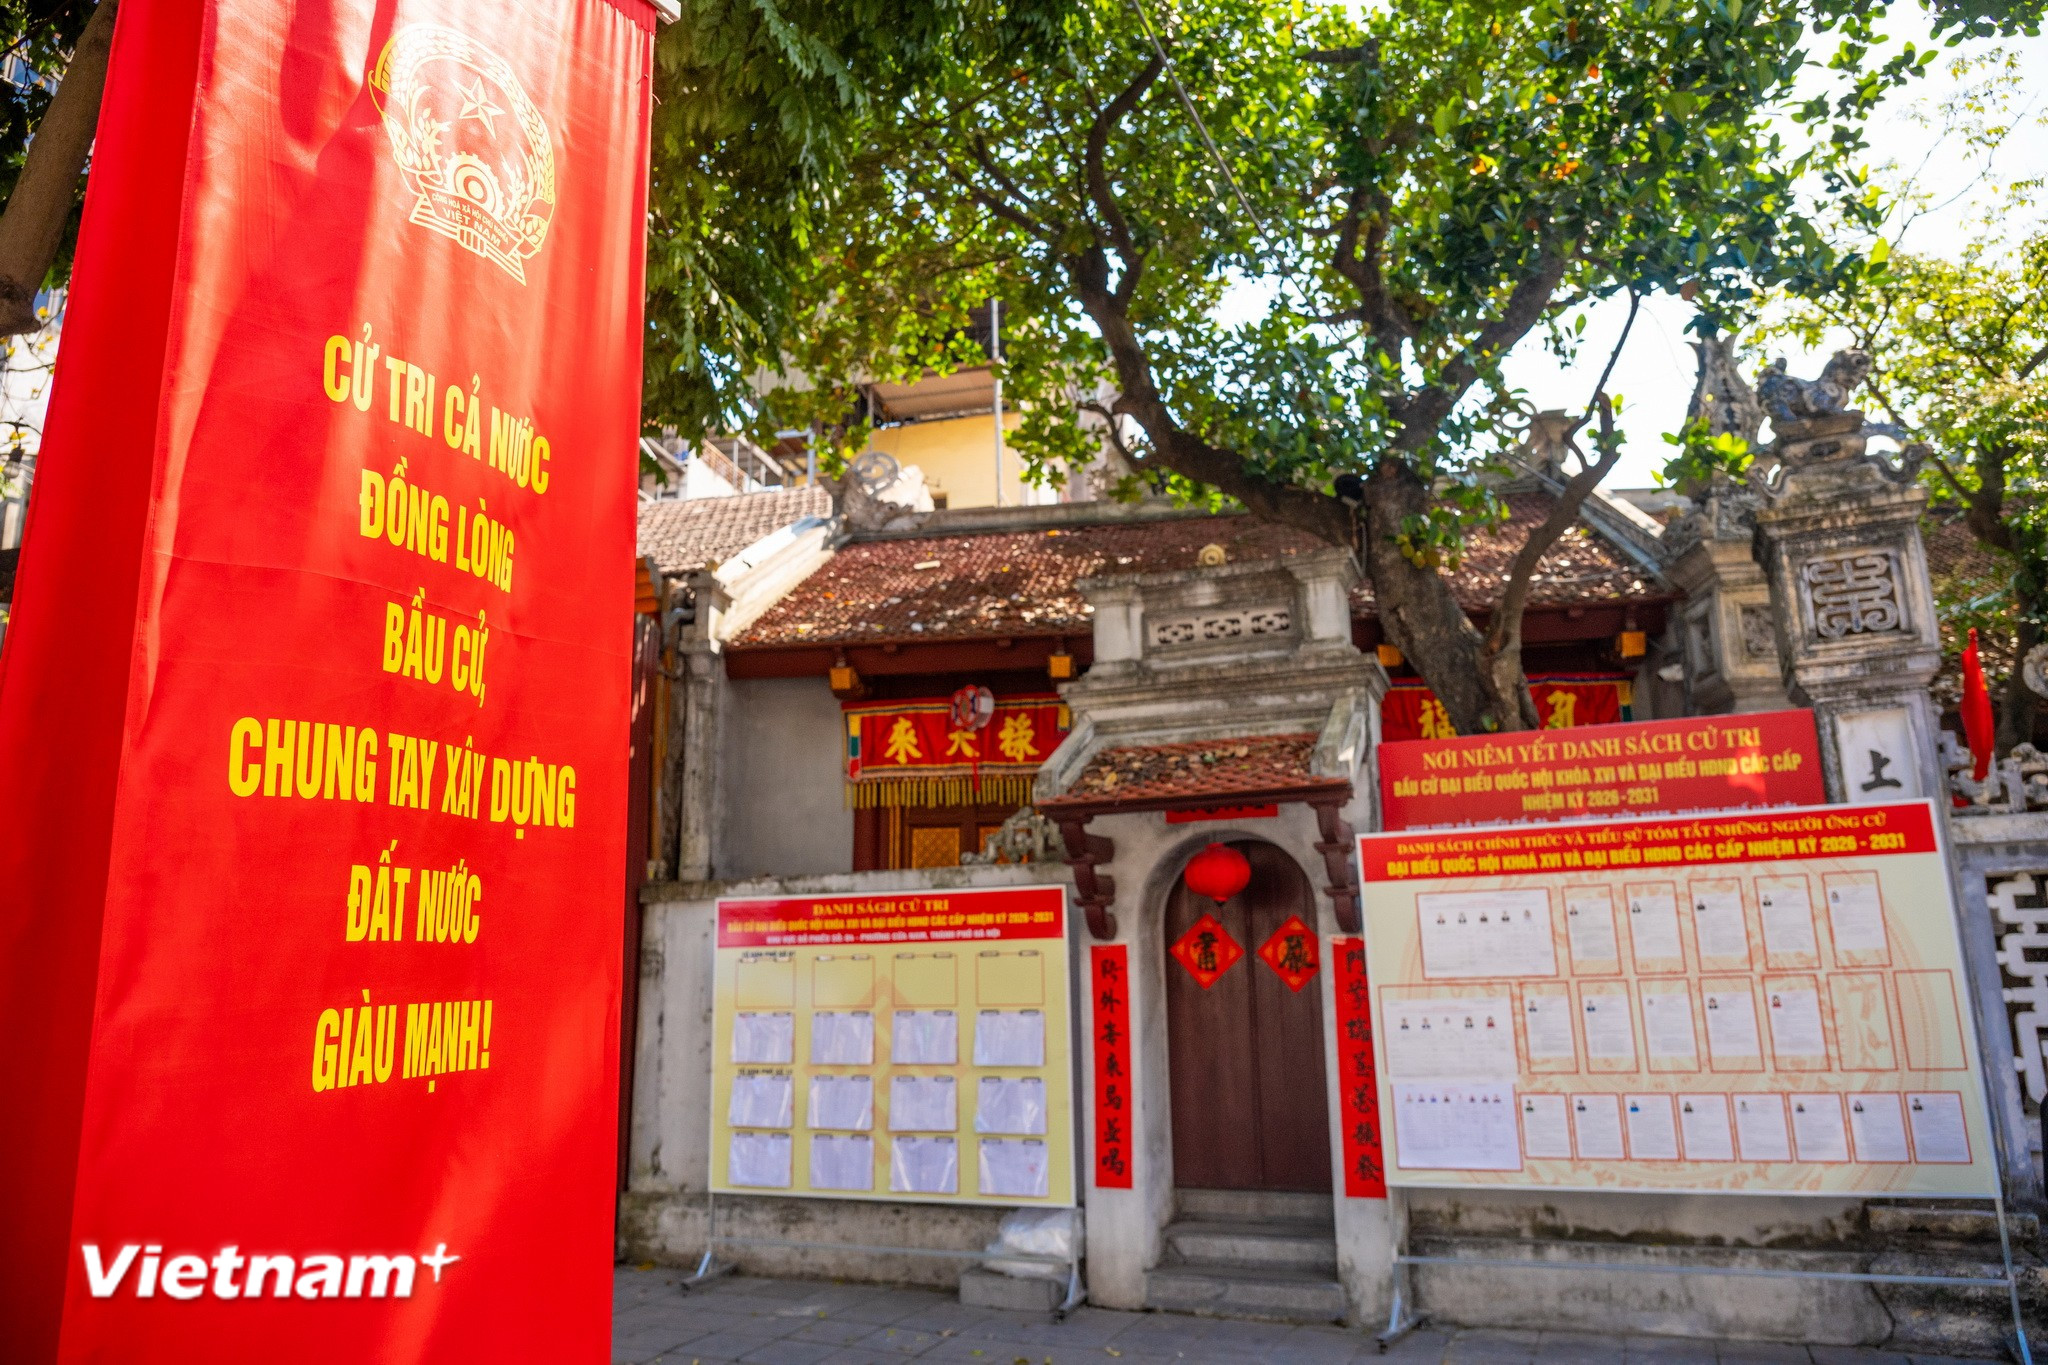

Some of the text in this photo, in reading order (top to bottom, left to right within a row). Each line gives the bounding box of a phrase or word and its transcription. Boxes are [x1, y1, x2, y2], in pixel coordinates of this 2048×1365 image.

[442, 208, 501, 247] VIỆT NAM
[323, 322, 551, 495] CỬ TRI CẢ NƯỚC
[359, 455, 515, 593] ĐỒNG LÒNG
[382, 586, 489, 708] BẦU CỬ,
[1423, 724, 1761, 770] NƠI NIÊM YẾT DANH SÁCH CỬ TRI
[228, 716, 576, 839] CHUNG TAY XÂY DỰNG
[1420, 774, 1438, 796] CỬ
[1494, 768, 1529, 791] QUỐC
[1531, 769, 1554, 790] HỘI
[1594, 766, 1616, 784] XVI
[1617, 762, 1636, 782] VÀ
[1740, 752, 1769, 774] CÁC
[1772, 748, 1802, 772] CẤP
[1567, 790, 1584, 809] KỲ
[1397, 842, 1435, 855] DANH
[1436, 838, 1473, 854] SÁCH
[1475, 835, 1521, 853] CHÍNH
[1522, 832, 1562, 849] THỨC
[1563, 830, 1584, 846] VÀ
[1643, 823, 1679, 842] TÓM
[1714, 820, 1769, 838] NHỮNG
[1771, 816, 1823, 835] NGƯỜI
[1825, 814, 1860, 831] ỨNG
[1862, 810, 1887, 828] CỬ
[1441, 853, 1476, 874] QUỐC
[1478, 854, 1500, 874] HỘI
[1540, 852, 1562, 869] XVI
[1563, 849, 1583, 867] VÀ
[1684, 841, 1713, 861] CÁC
[1715, 838, 1745, 859] CẤP
[1747, 838, 1795, 859] NHIỆM
[1798, 835, 1817, 853] KỲ
[1820, 835, 1857, 853] 2026
[1869, 832, 1906, 850] 2031
[346, 839, 481, 944] ĐẤT NƯỚC
[813, 898, 949, 917] DANH SÁCH CỬ TRI
[311, 988, 493, 1094] GIÀU MẠNH!
